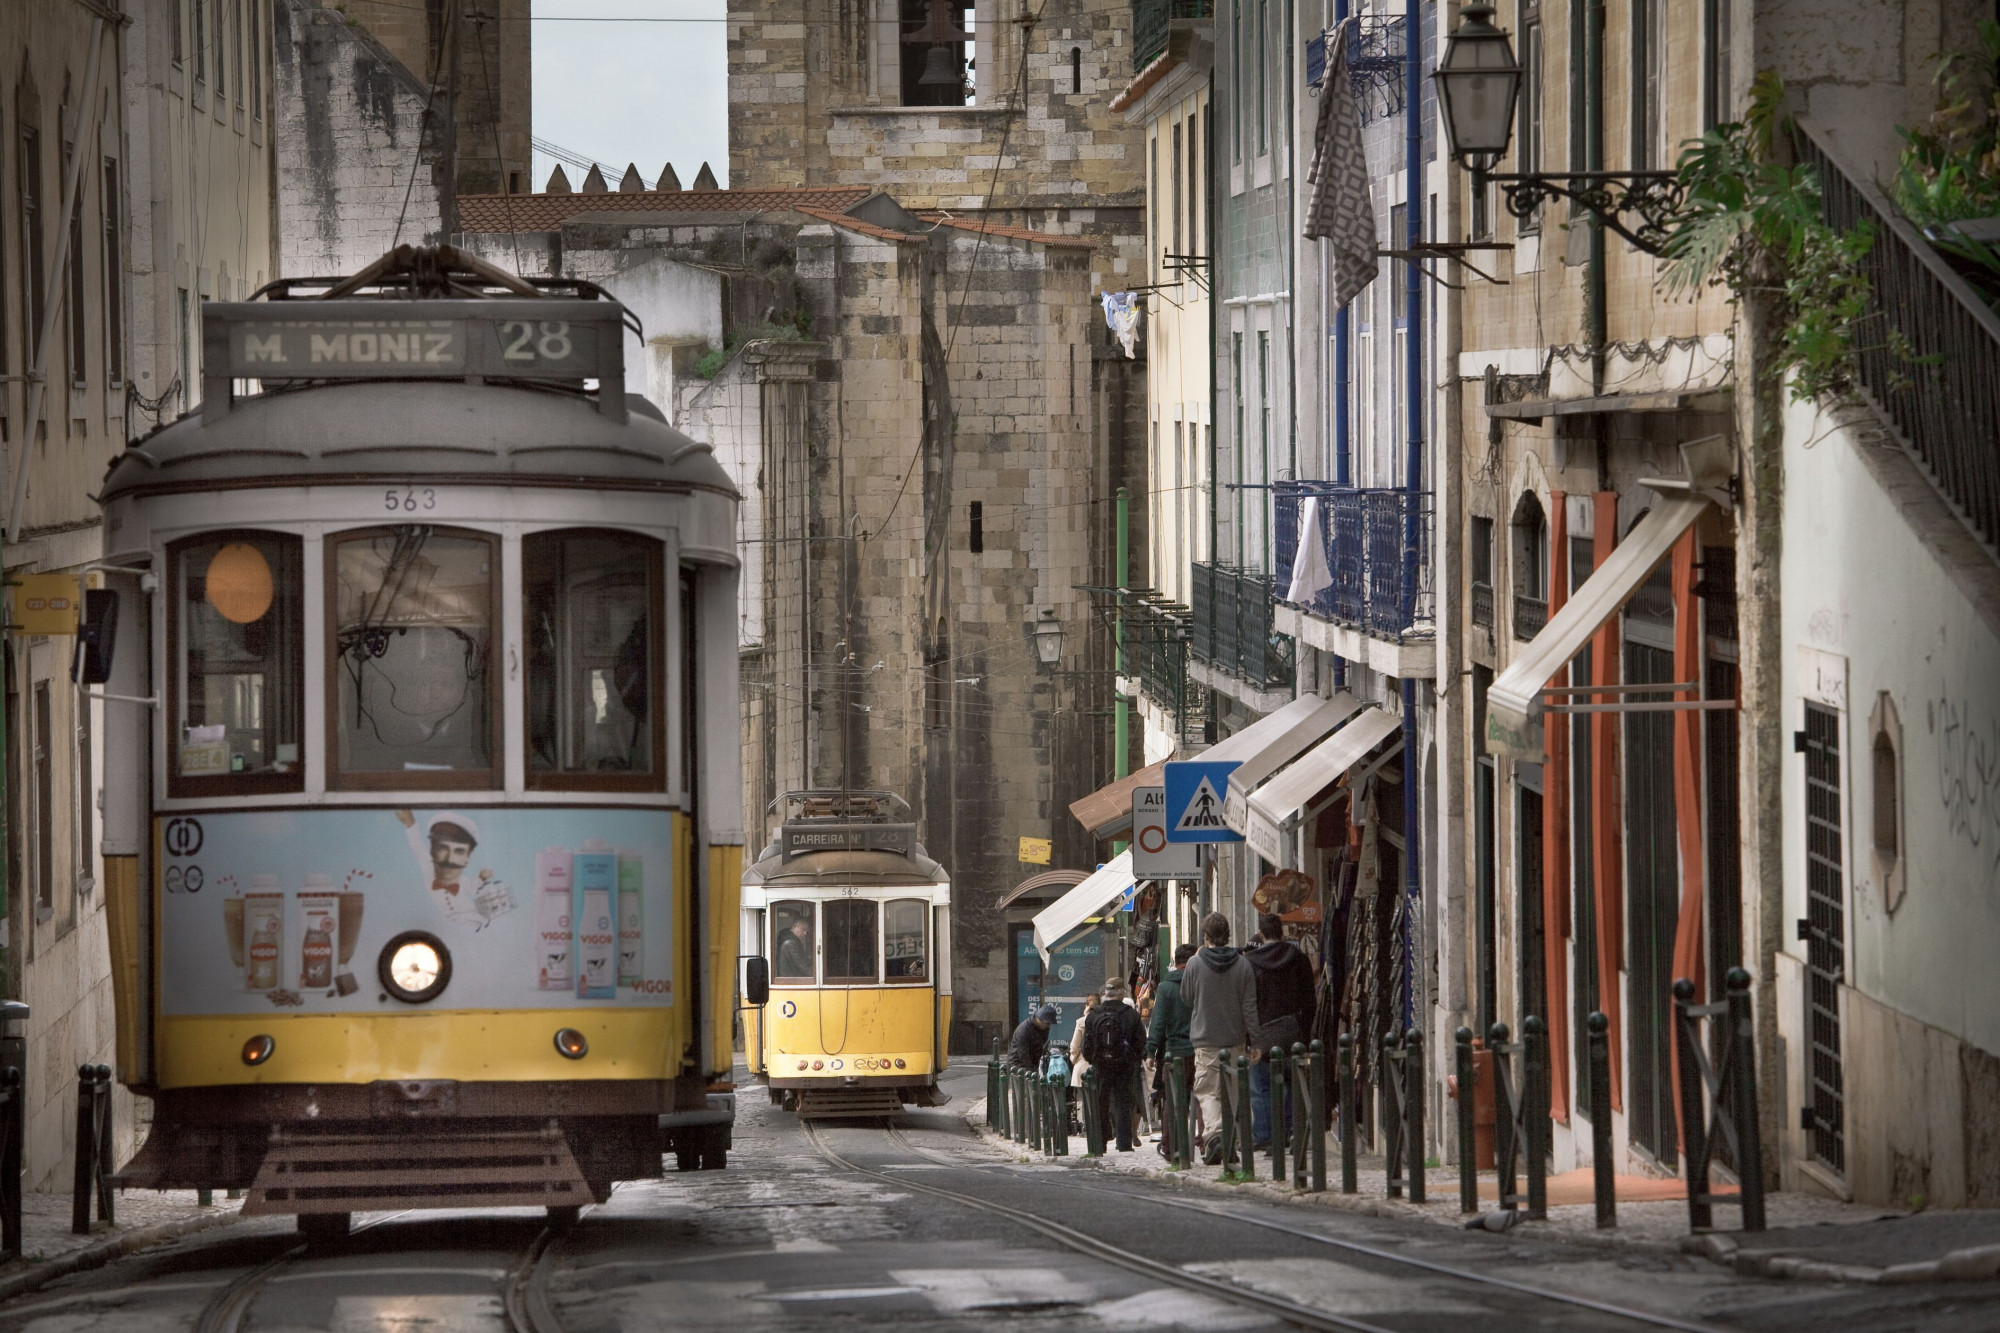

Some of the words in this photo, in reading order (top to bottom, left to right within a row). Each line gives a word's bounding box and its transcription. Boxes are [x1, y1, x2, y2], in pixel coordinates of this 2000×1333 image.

[503, 320, 573, 361] 28
[244, 334, 287, 362] M.
[310, 334, 453, 362] MONIZ
[385, 488, 437, 512] 563
[792, 834, 845, 845] CARREIRA
[876, 831, 900, 843] 28
[841, 887, 859, 896] 562
[541, 931, 573, 941] VIGOR
[580, 935, 613, 944] VIGOR
[1083, 946, 1099, 954] 4G?
[631, 979, 672, 993] VIGOR
